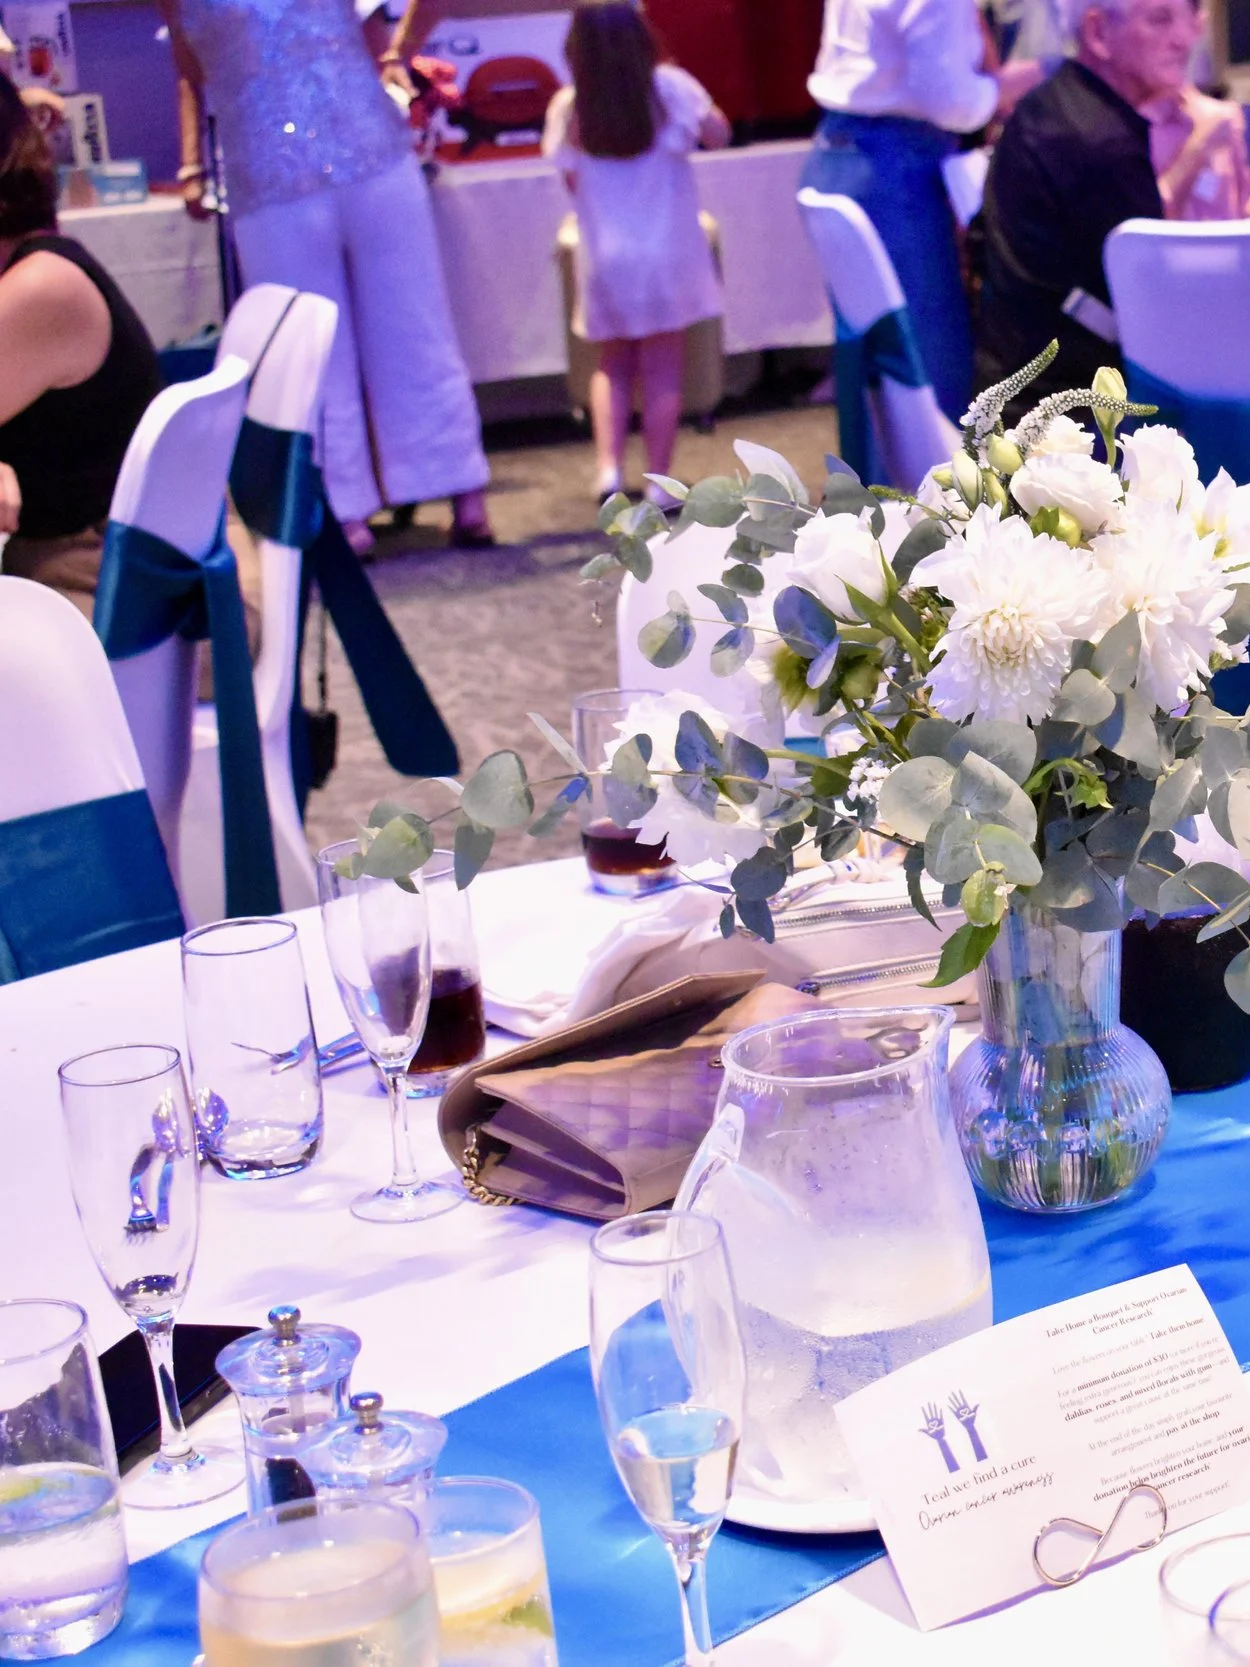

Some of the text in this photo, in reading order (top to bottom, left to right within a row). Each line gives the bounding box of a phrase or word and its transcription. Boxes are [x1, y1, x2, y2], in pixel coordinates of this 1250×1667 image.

[1046, 1327, 1065, 1338] Take
[1065, 1320, 1086, 1331] Home
[1092, 1306, 1123, 1322] Bouquet
[1123, 1304, 1131, 1312] &
[1131, 1295, 1160, 1309] Support
[1159, 1288, 1187, 1299] Ovarian
[1092, 1322, 1118, 1335] Cancer
[1150, 1330, 1167, 1340] Take
[1168, 1324, 1186, 1334] them
[1077, 1375, 1110, 1391] minimum
[1110, 1363, 1144, 1379] donation
[1144, 1359, 1152, 1367] of
[1152, 1352, 1169, 1363] $30
[1119, 1390, 1134, 1402] and
[1134, 1381, 1156, 1396] mixed
[1155, 1374, 1180, 1388] florals
[1180, 1368, 1196, 1379] with
[1165, 1427, 1179, 1437] pay
[1180, 1422, 1188, 1430] at
[1189, 1417, 1201, 1426] the
[1228, 1426, 1244, 1438] your
[921, 1455, 1037, 1505] Teal we find a cure
[1093, 1484, 1130, 1502] donation
[1127, 1473, 1151, 1490] helps
[1149, 1462, 1183, 1479] brighten
[1183, 1458, 1195, 1467] the
[1196, 1448, 1218, 1462] future
[1219, 1443, 1230, 1452] for
[1153, 1477, 1176, 1490] ancer
[918, 1472, 1055, 1531] Ovarian cancer awareness
